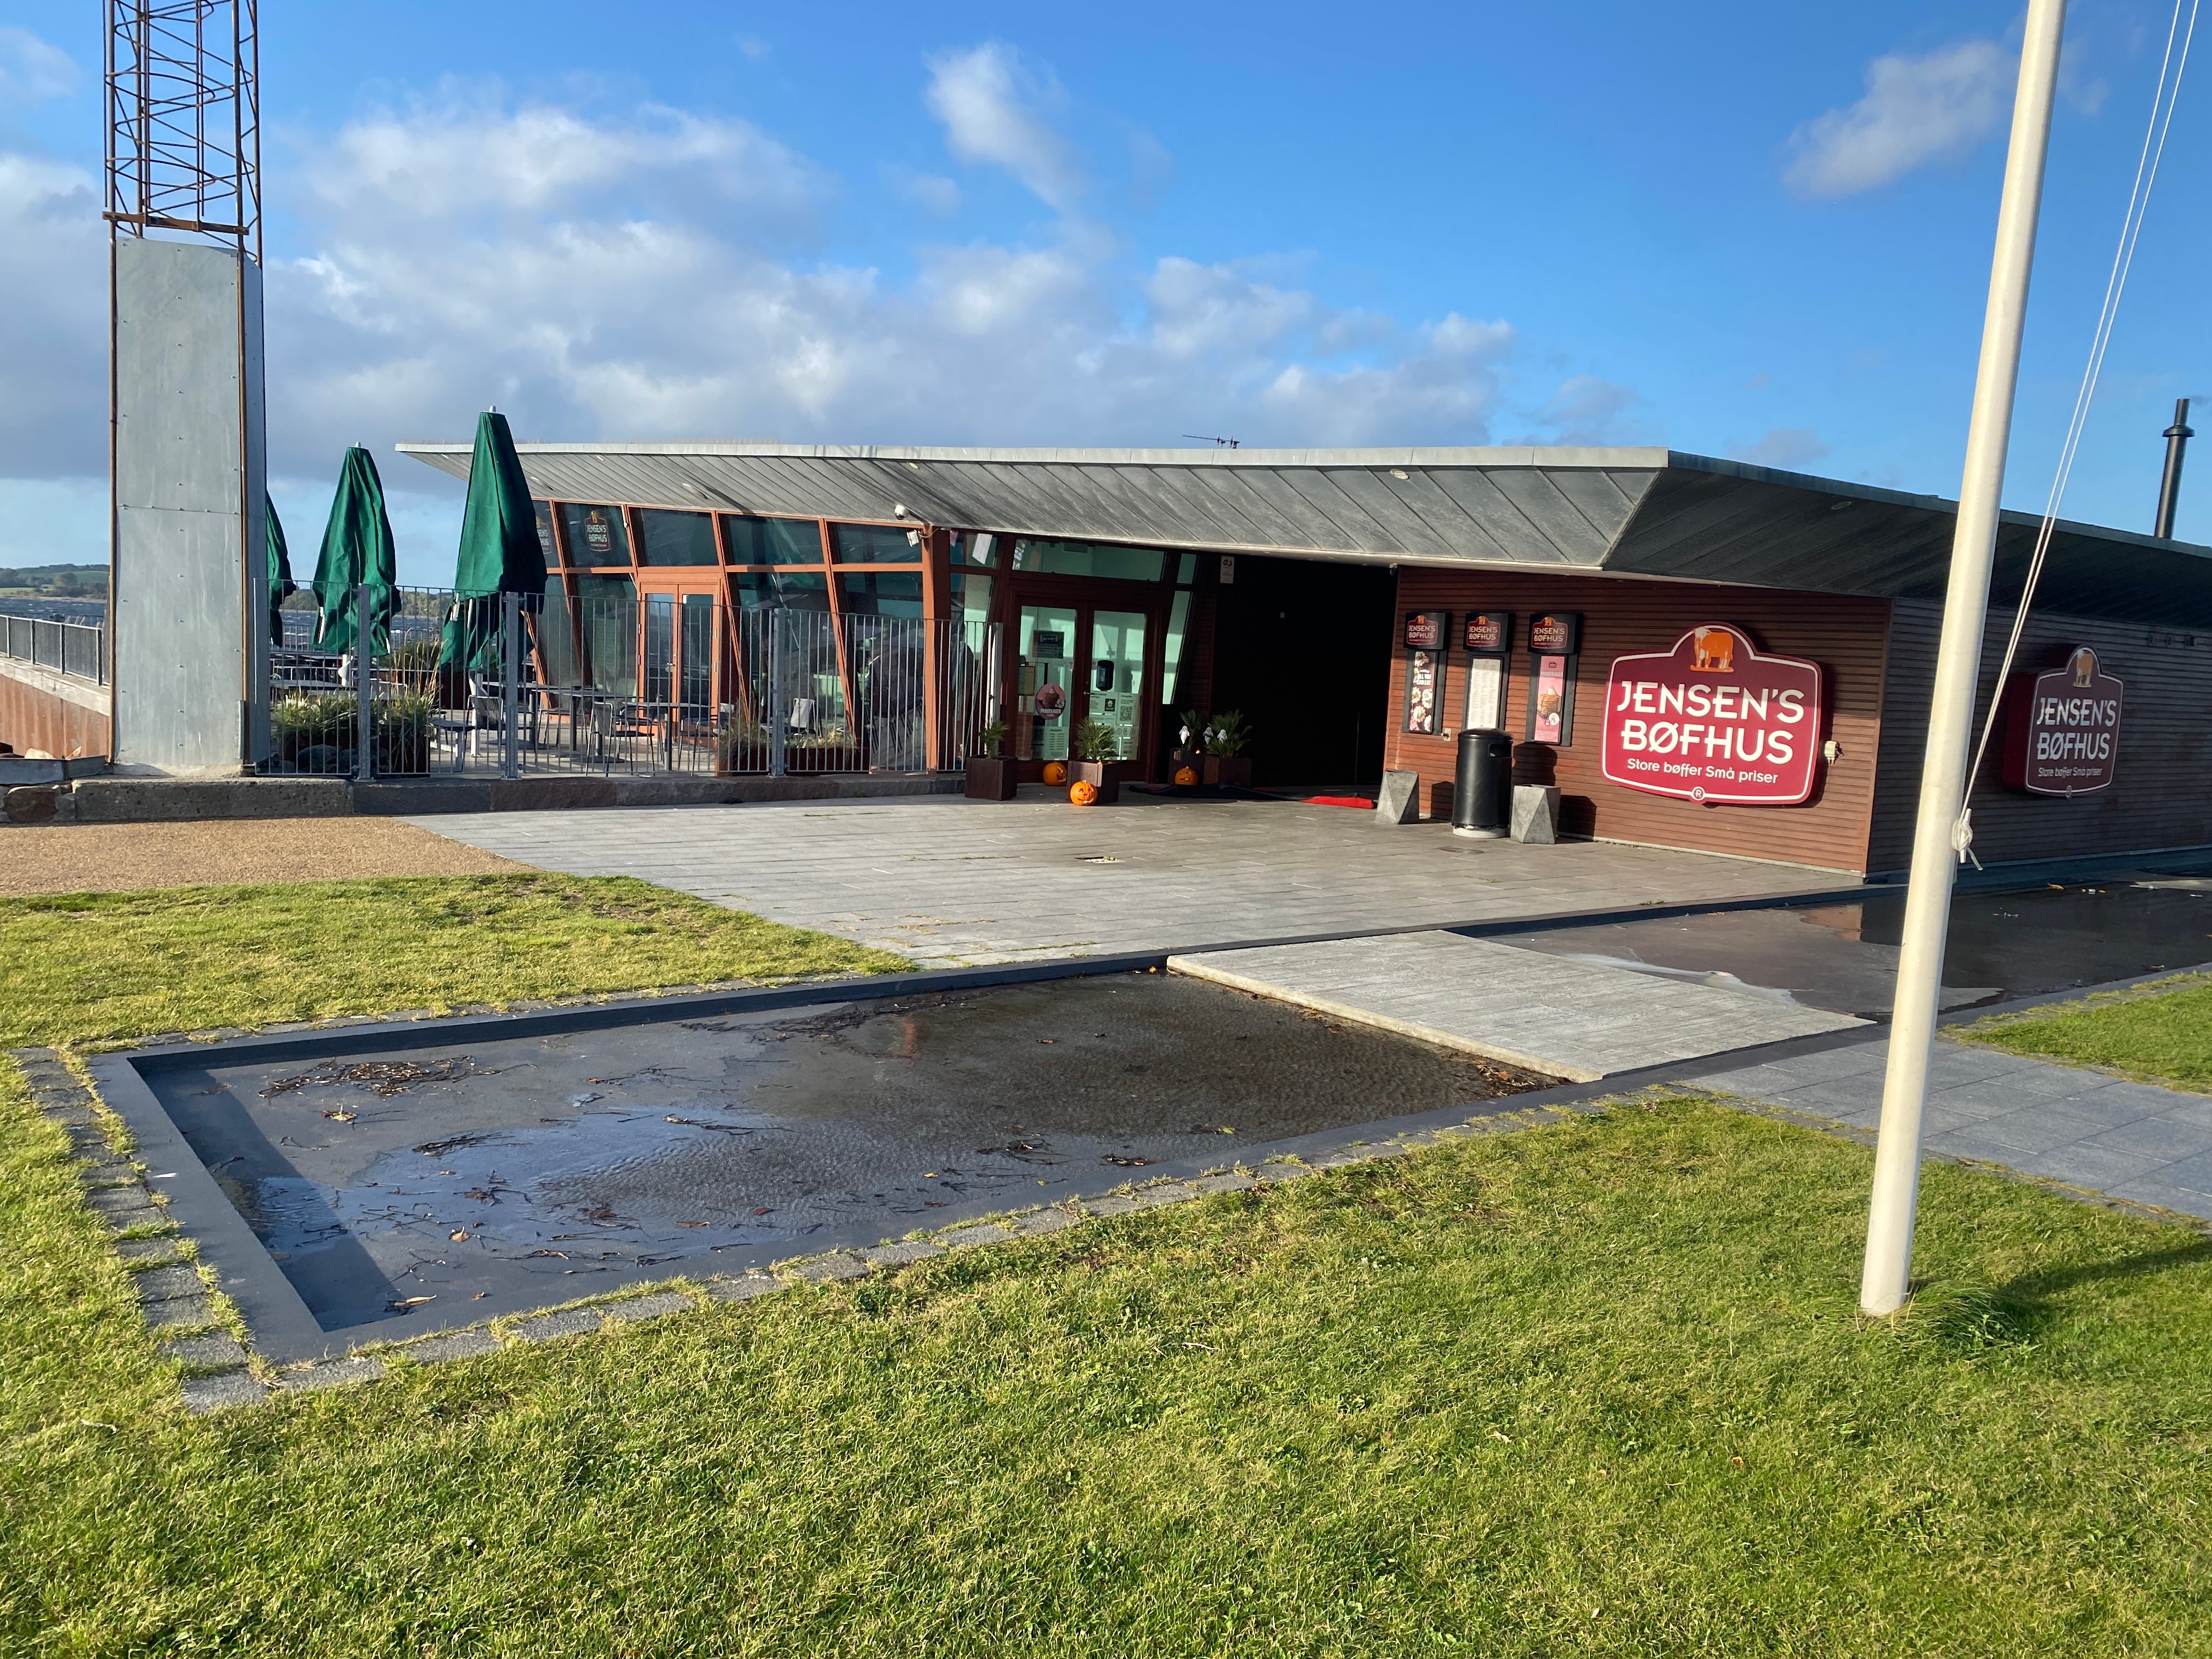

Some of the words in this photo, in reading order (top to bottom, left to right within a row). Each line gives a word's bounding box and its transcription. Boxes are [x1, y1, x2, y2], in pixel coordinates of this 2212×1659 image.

[1617, 680, 1805, 724] JENSEN'S
[2036, 697, 2117, 727] JENSEN'S
[1621, 719, 1794, 764] BØFHUS
[2036, 731, 2111, 760] BØFHUS
[1627, 758, 1660, 772] Store
[1663, 761, 1702, 778] bøffer
[1706, 765, 1735, 780] Små
[1738, 769, 1779, 784] priser
[2038, 767, 2054, 777] Store
[2086, 768, 2103, 778] priser
